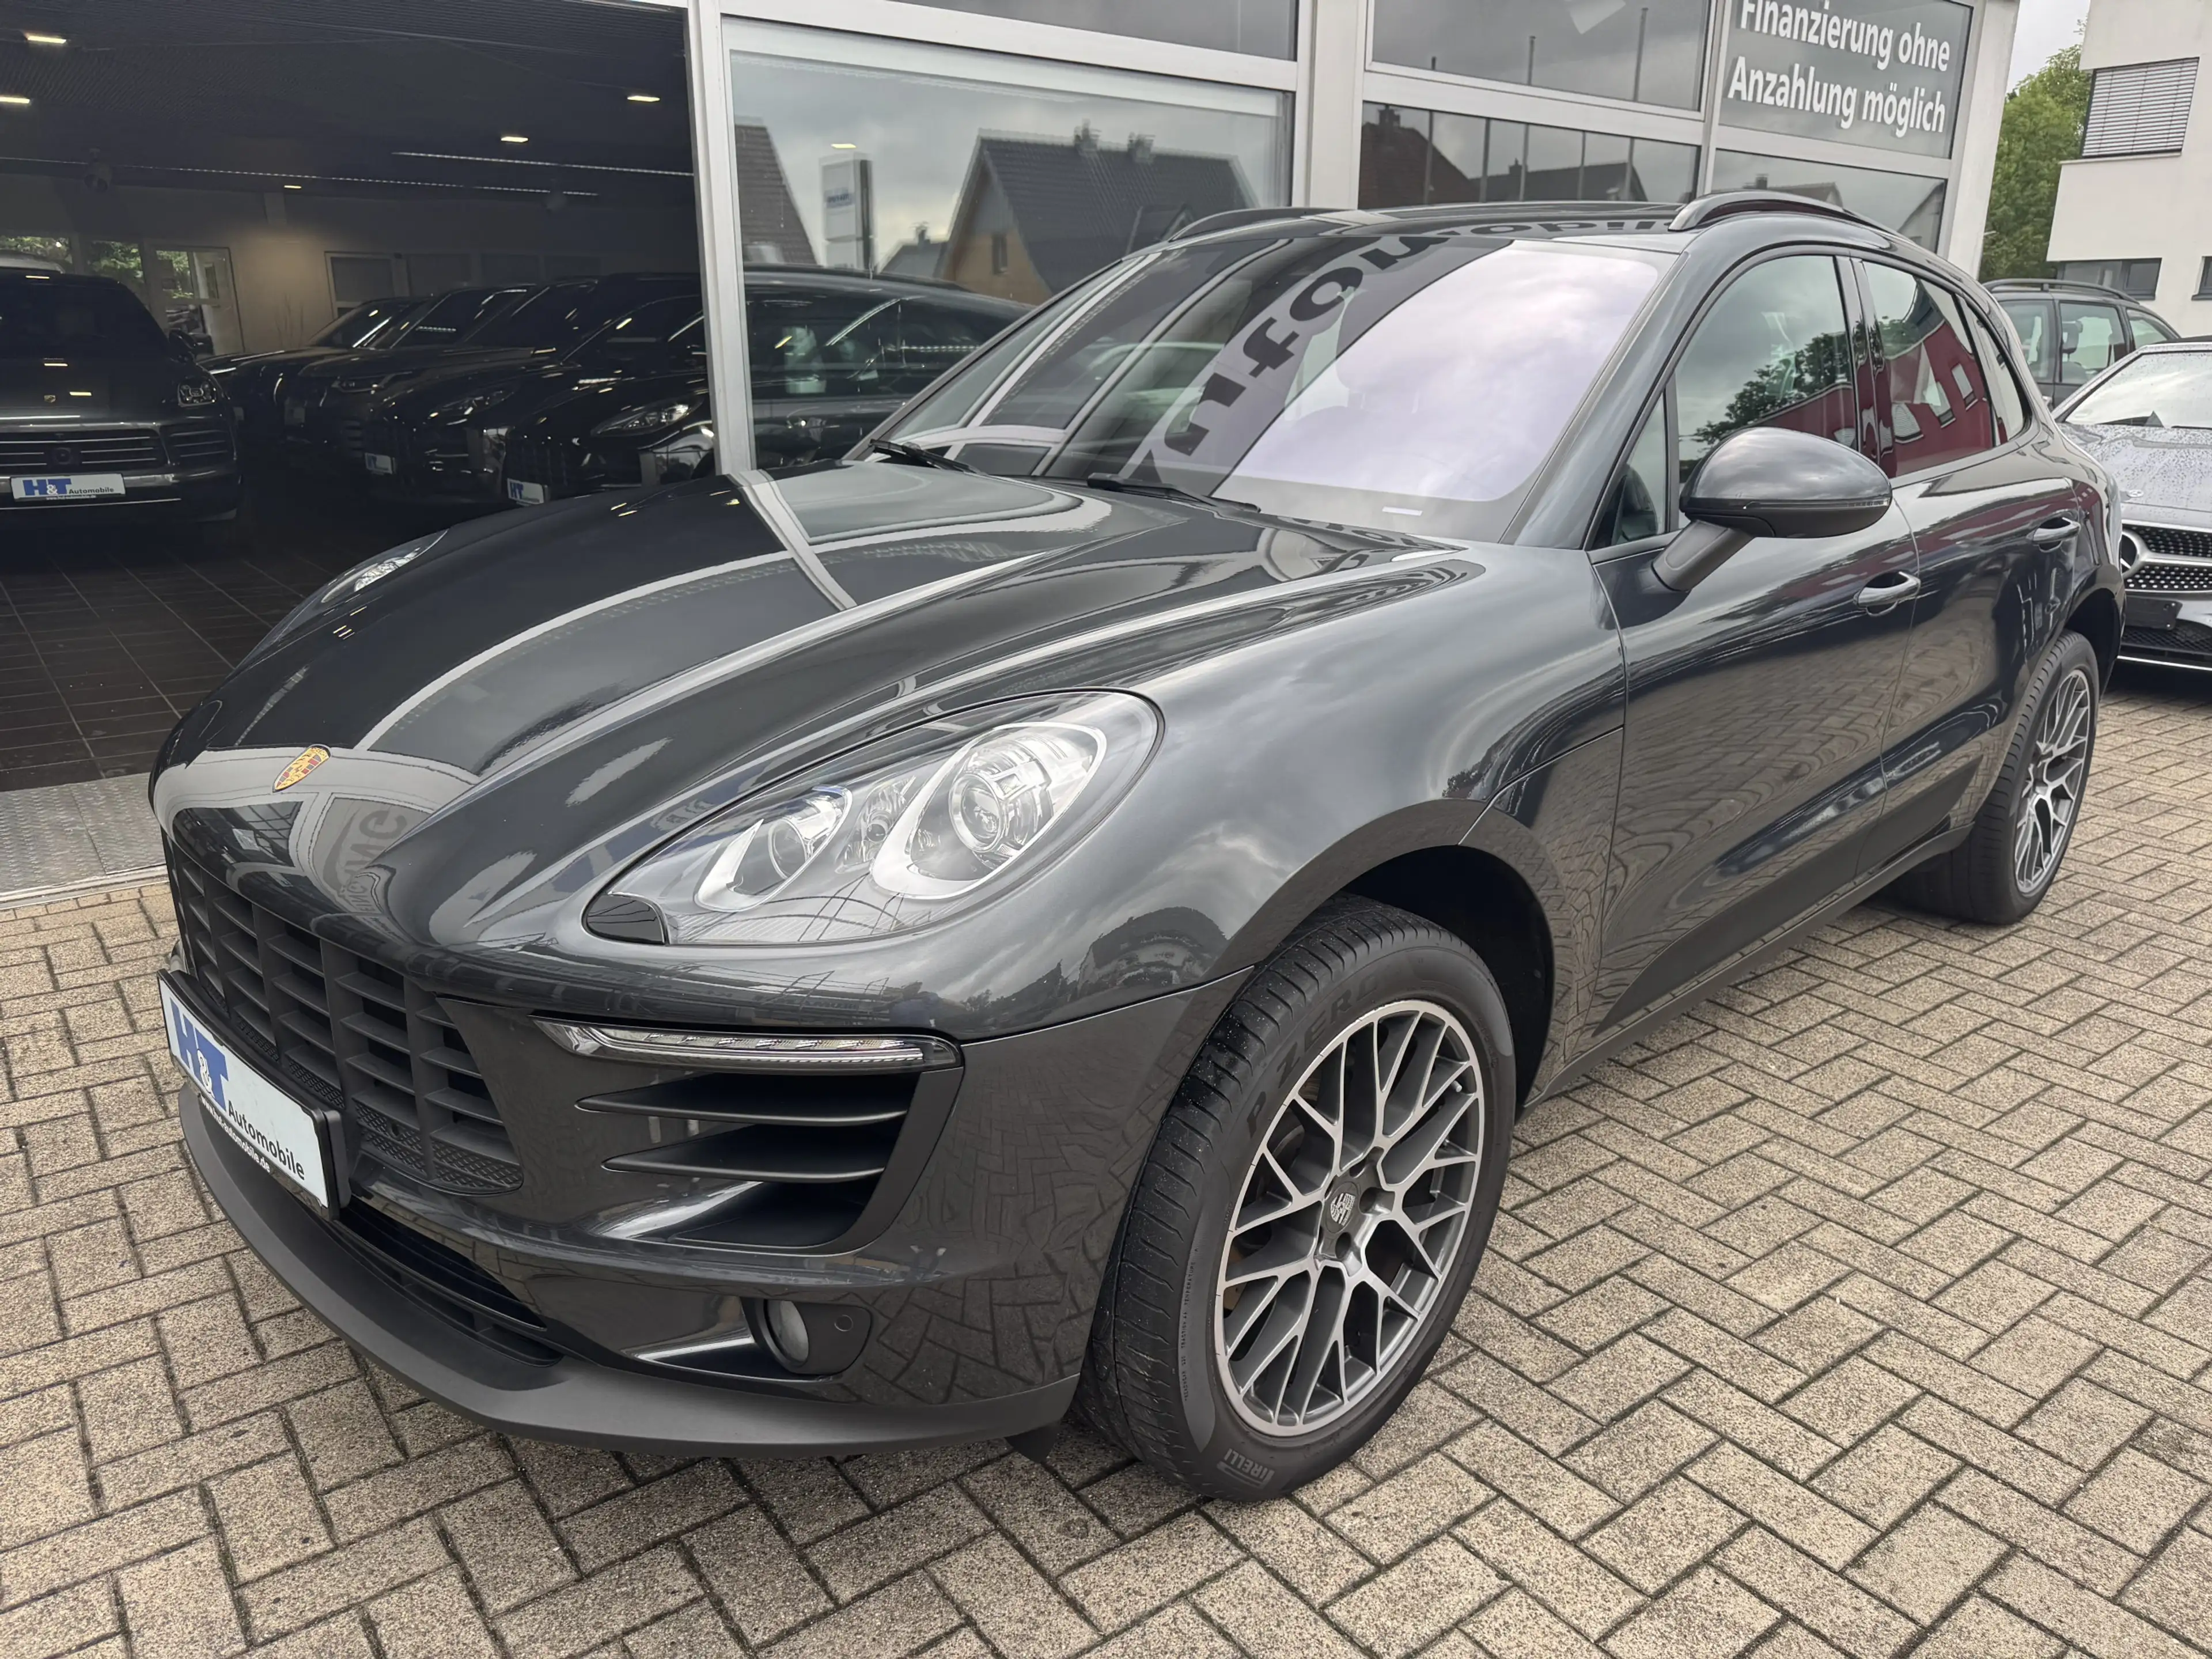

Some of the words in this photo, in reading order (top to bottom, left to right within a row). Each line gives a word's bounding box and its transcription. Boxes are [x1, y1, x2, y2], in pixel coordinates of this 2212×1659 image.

[1740, 0, 1893, 70] Finanzierung
[1899, 22, 1950, 71] ohne
[1728, 56, 1857, 128] Anzahlung
[1862, 82, 1946, 138] möglich
[22, 478, 71, 495] H&T
[170, 997, 229, 1111] H&T
[228, 1100, 305, 1180] Automobile
[1217, 1448, 1275, 1489] PIRELLI
